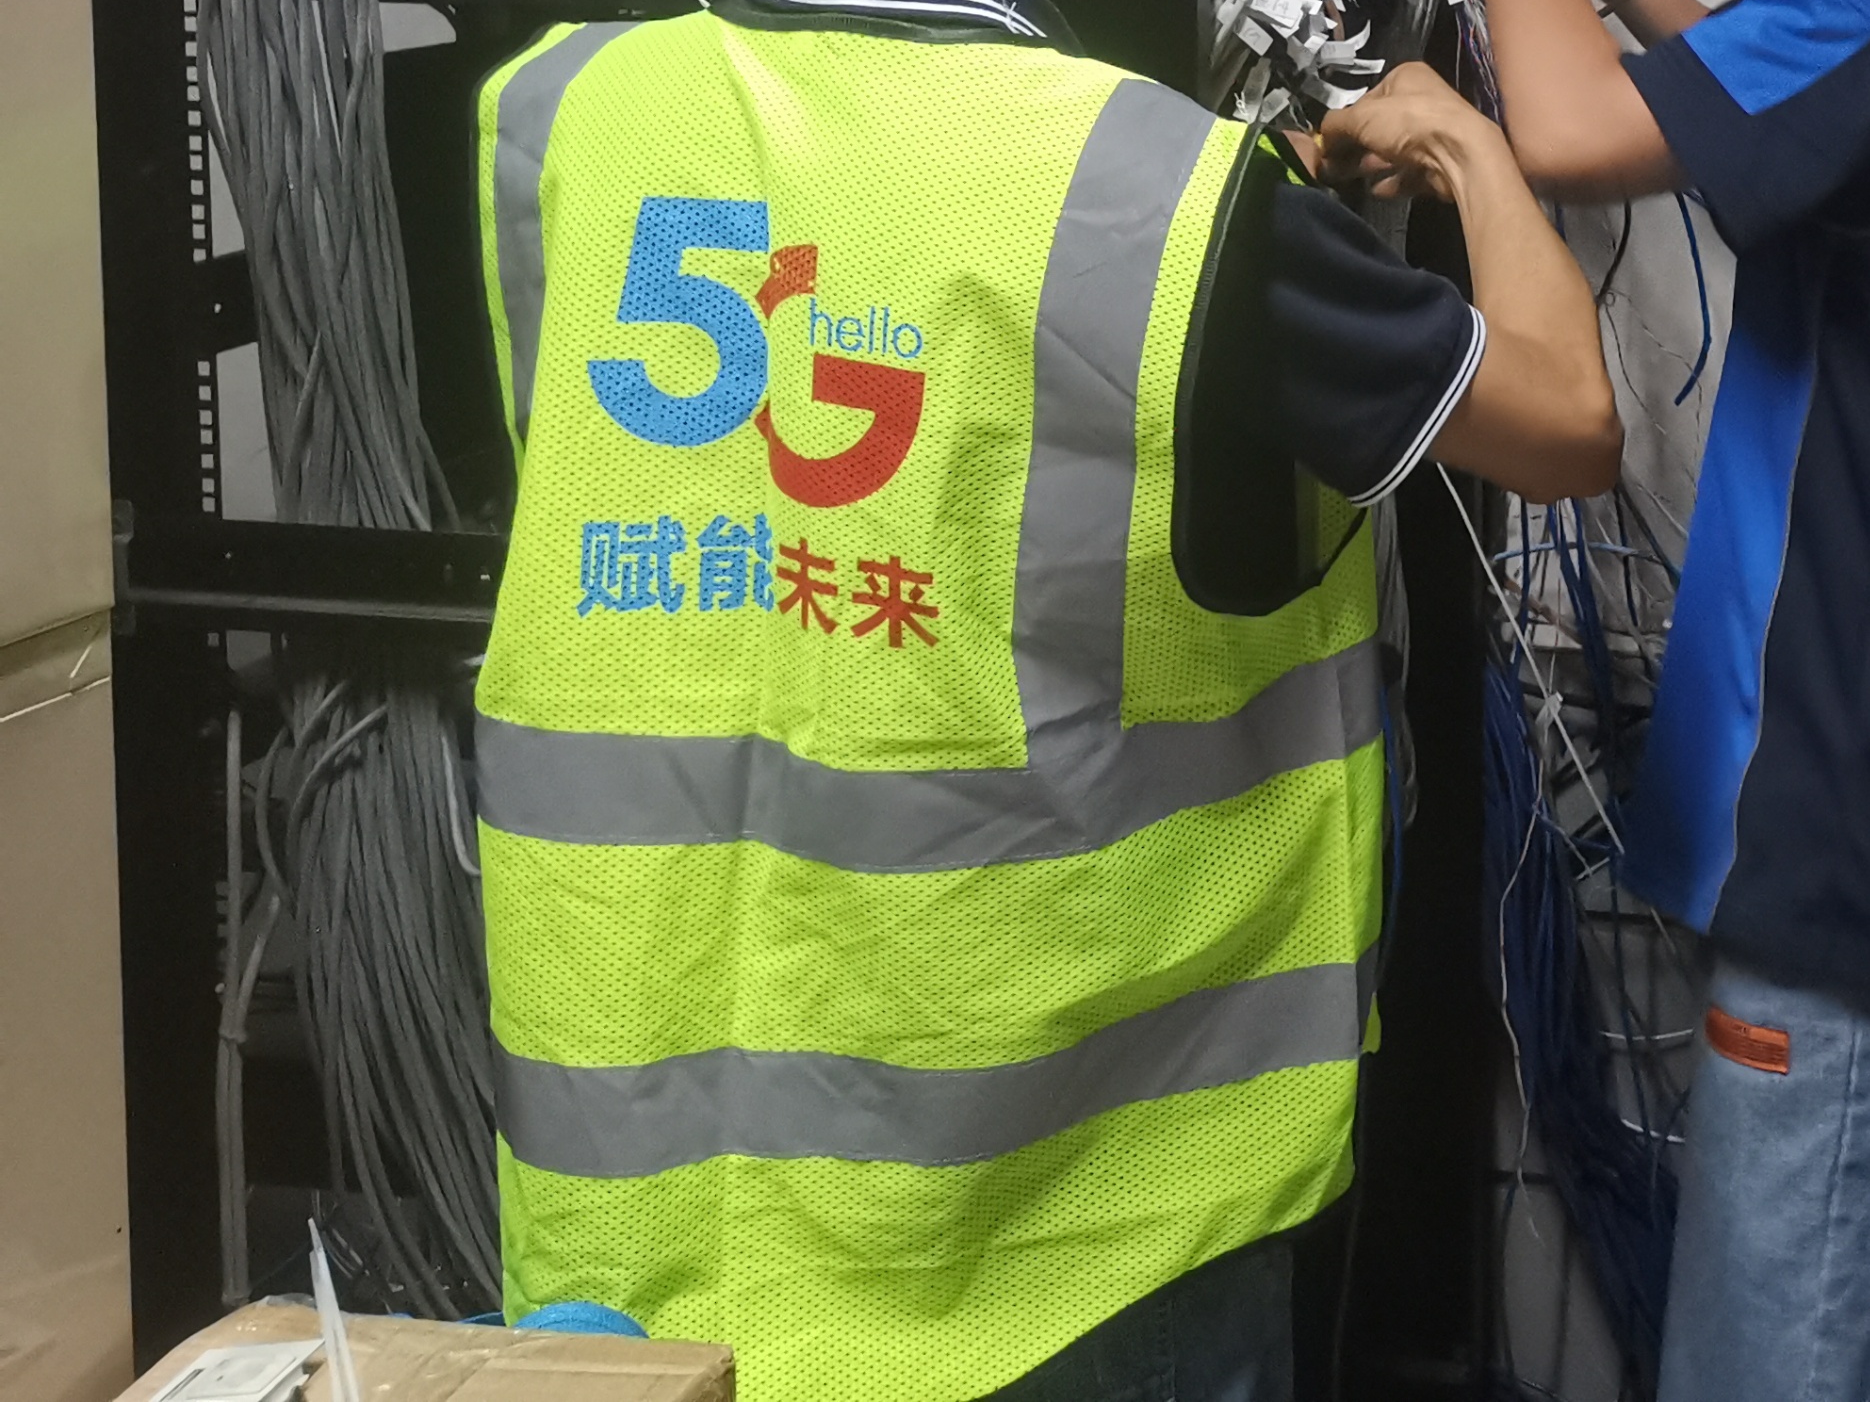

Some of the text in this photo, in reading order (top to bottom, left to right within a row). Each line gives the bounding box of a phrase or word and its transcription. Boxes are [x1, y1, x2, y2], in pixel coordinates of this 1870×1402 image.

[587, 197, 925, 508] 5G
[809, 299, 923, 358] hello
[576, 513, 939, 648] 赋能未来
